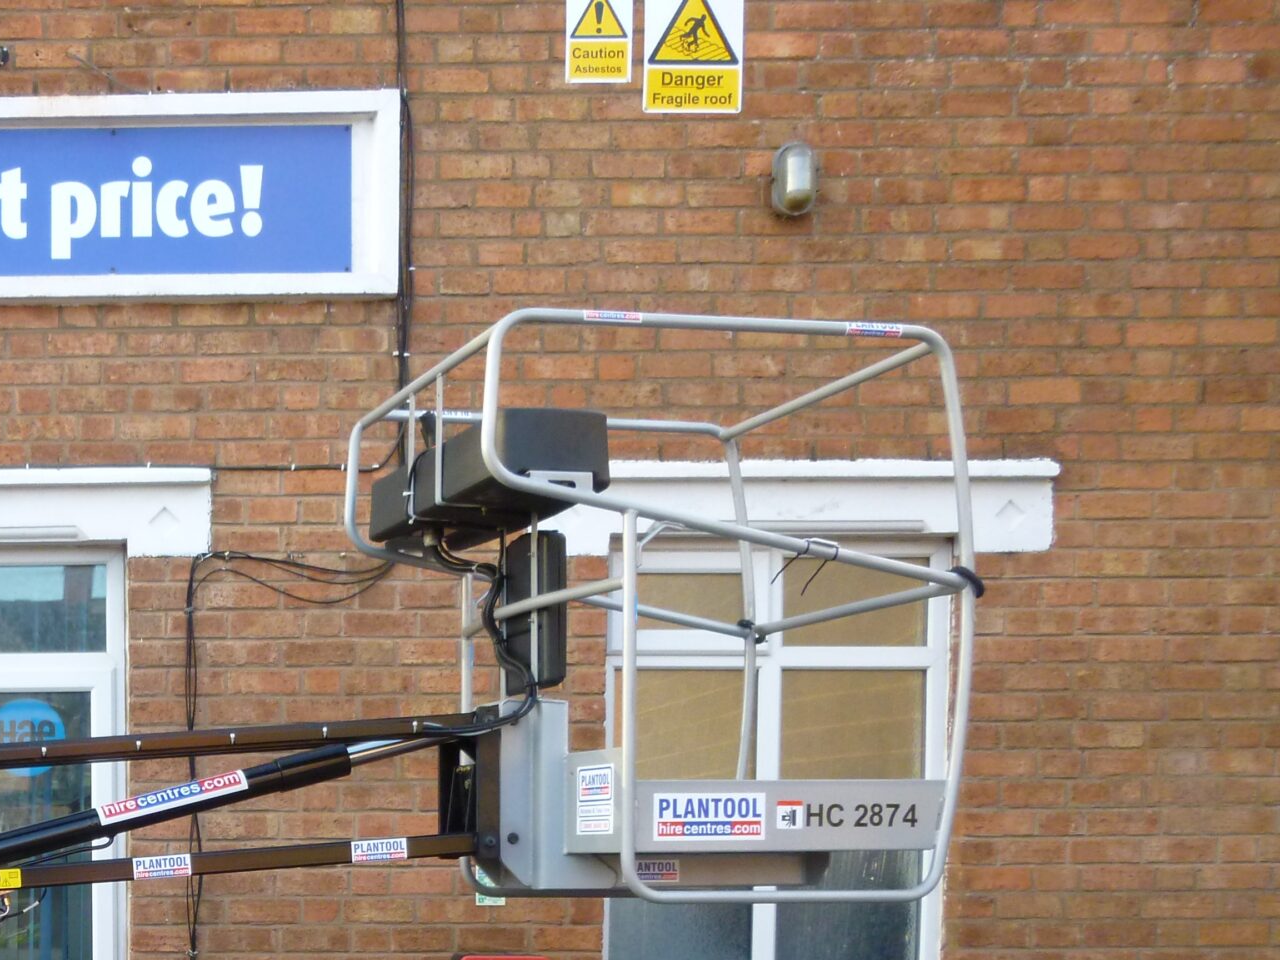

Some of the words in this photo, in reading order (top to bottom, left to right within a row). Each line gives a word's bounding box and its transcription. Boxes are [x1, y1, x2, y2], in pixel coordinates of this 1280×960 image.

[572, 47, 624, 59] Caution
[575, 64, 622, 74] Asbestos
[661, 71, 724, 89] Danger
[652, 92, 700, 107] Fragile
[704, 92, 733, 105] roof
[50, 155, 264, 261] price!
[581, 773, 610, 786] PLANTOOL
[103, 772, 240, 817] hirecentres.com
[658, 798, 762, 819] PLANTOOL
[805, 803, 845, 828] HC
[853, 803, 918, 828] 2874
[658, 821, 761, 836] hirecentres.com
[354, 841, 405, 853] PLANTOOL
[135, 856, 189, 870] PLANTOOL
[637, 862, 677, 872] ANTOOL
[135, 867, 190, 878] hirecentres.com
